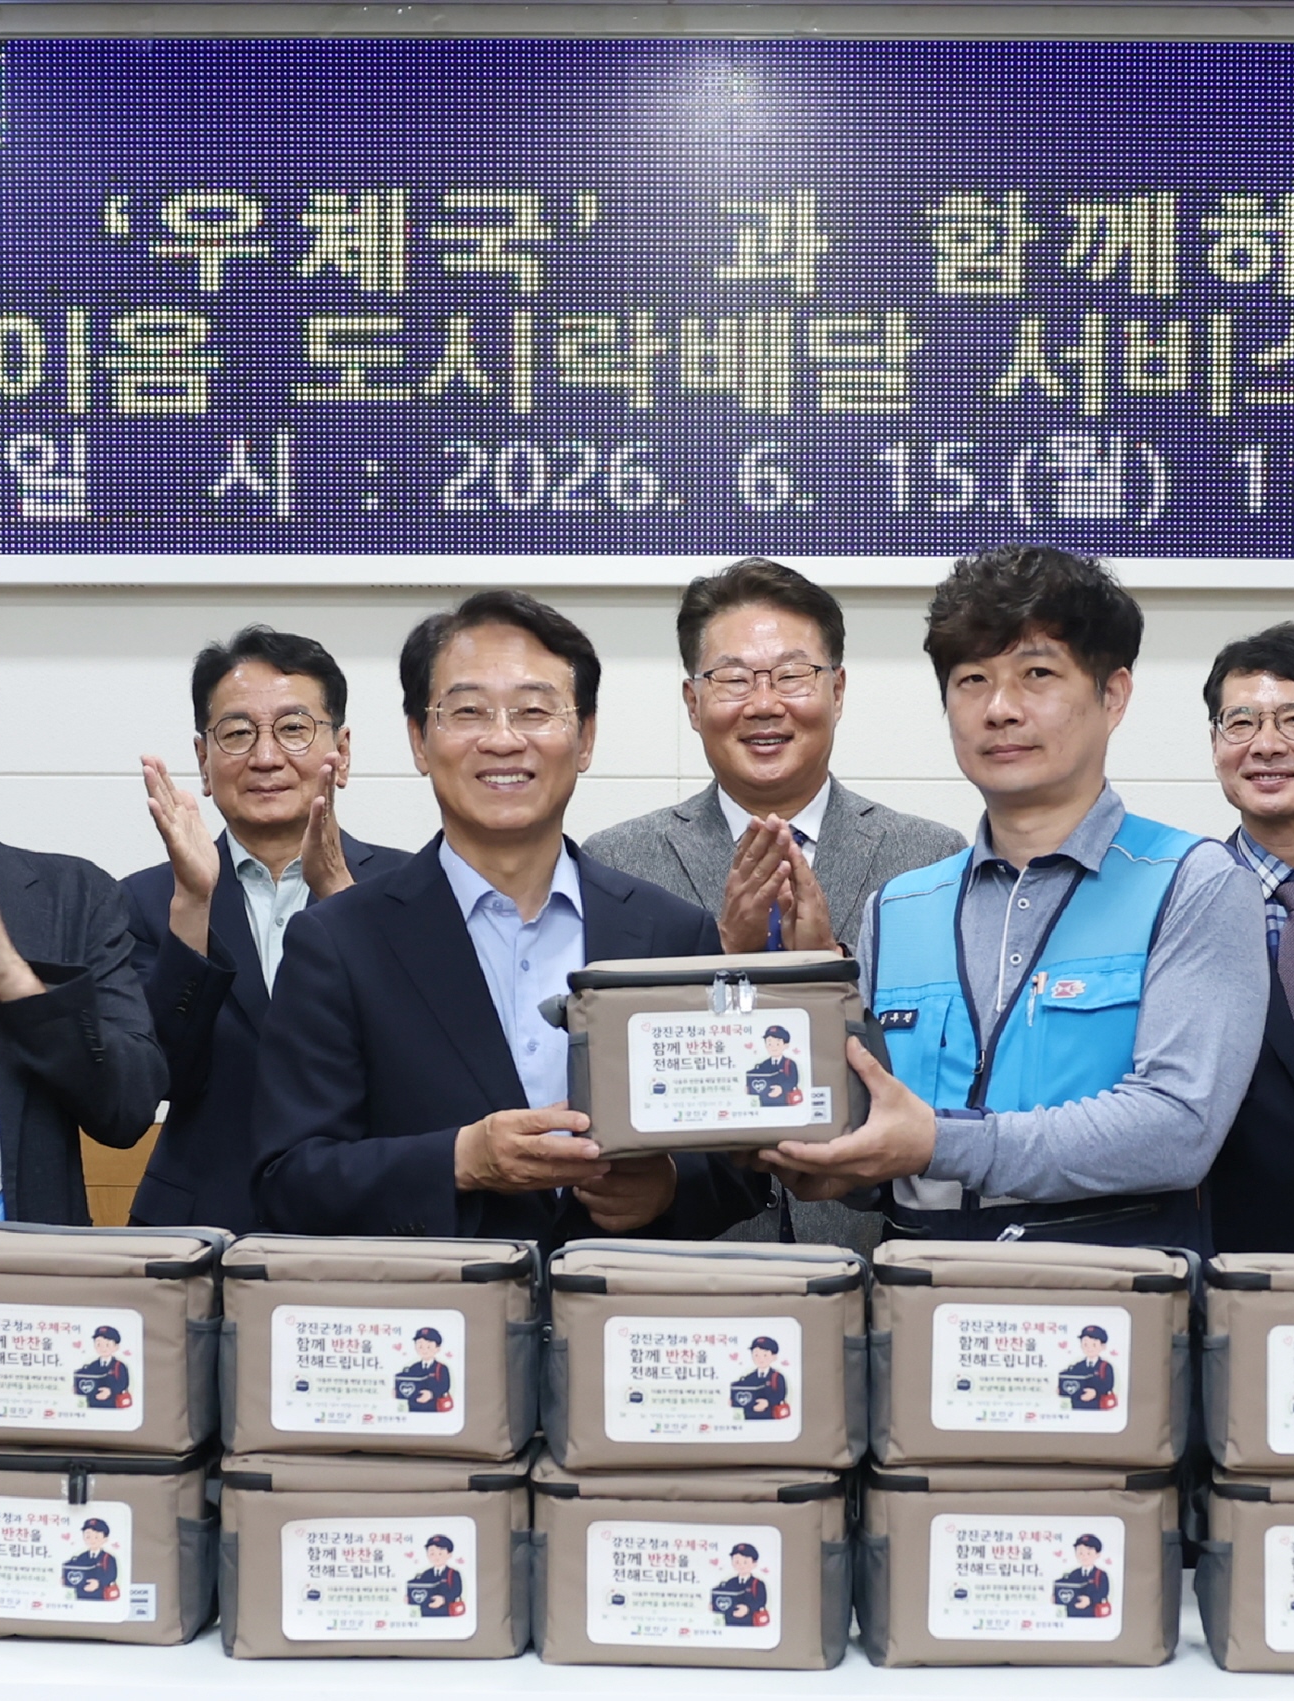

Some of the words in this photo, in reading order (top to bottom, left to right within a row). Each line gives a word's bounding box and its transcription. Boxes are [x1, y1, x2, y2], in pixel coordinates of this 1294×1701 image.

[713, 188, 829, 294] 과
[295, 309, 925, 415] 도시락배달
[6, 427, 87, 517] 일
[205, 427, 291, 517] 시
[441, 440, 683, 512] 2026.
[737, 441, 815, 513] 6.
[873, 428, 1166, 527] 15.(월)
[652, 1026, 705, 1038] 강진군청과
[653, 1042, 681, 1056] 함께
[686, 1040, 725, 1055] 반찬을
[653, 1058, 736, 1071] 전해드립니다.
